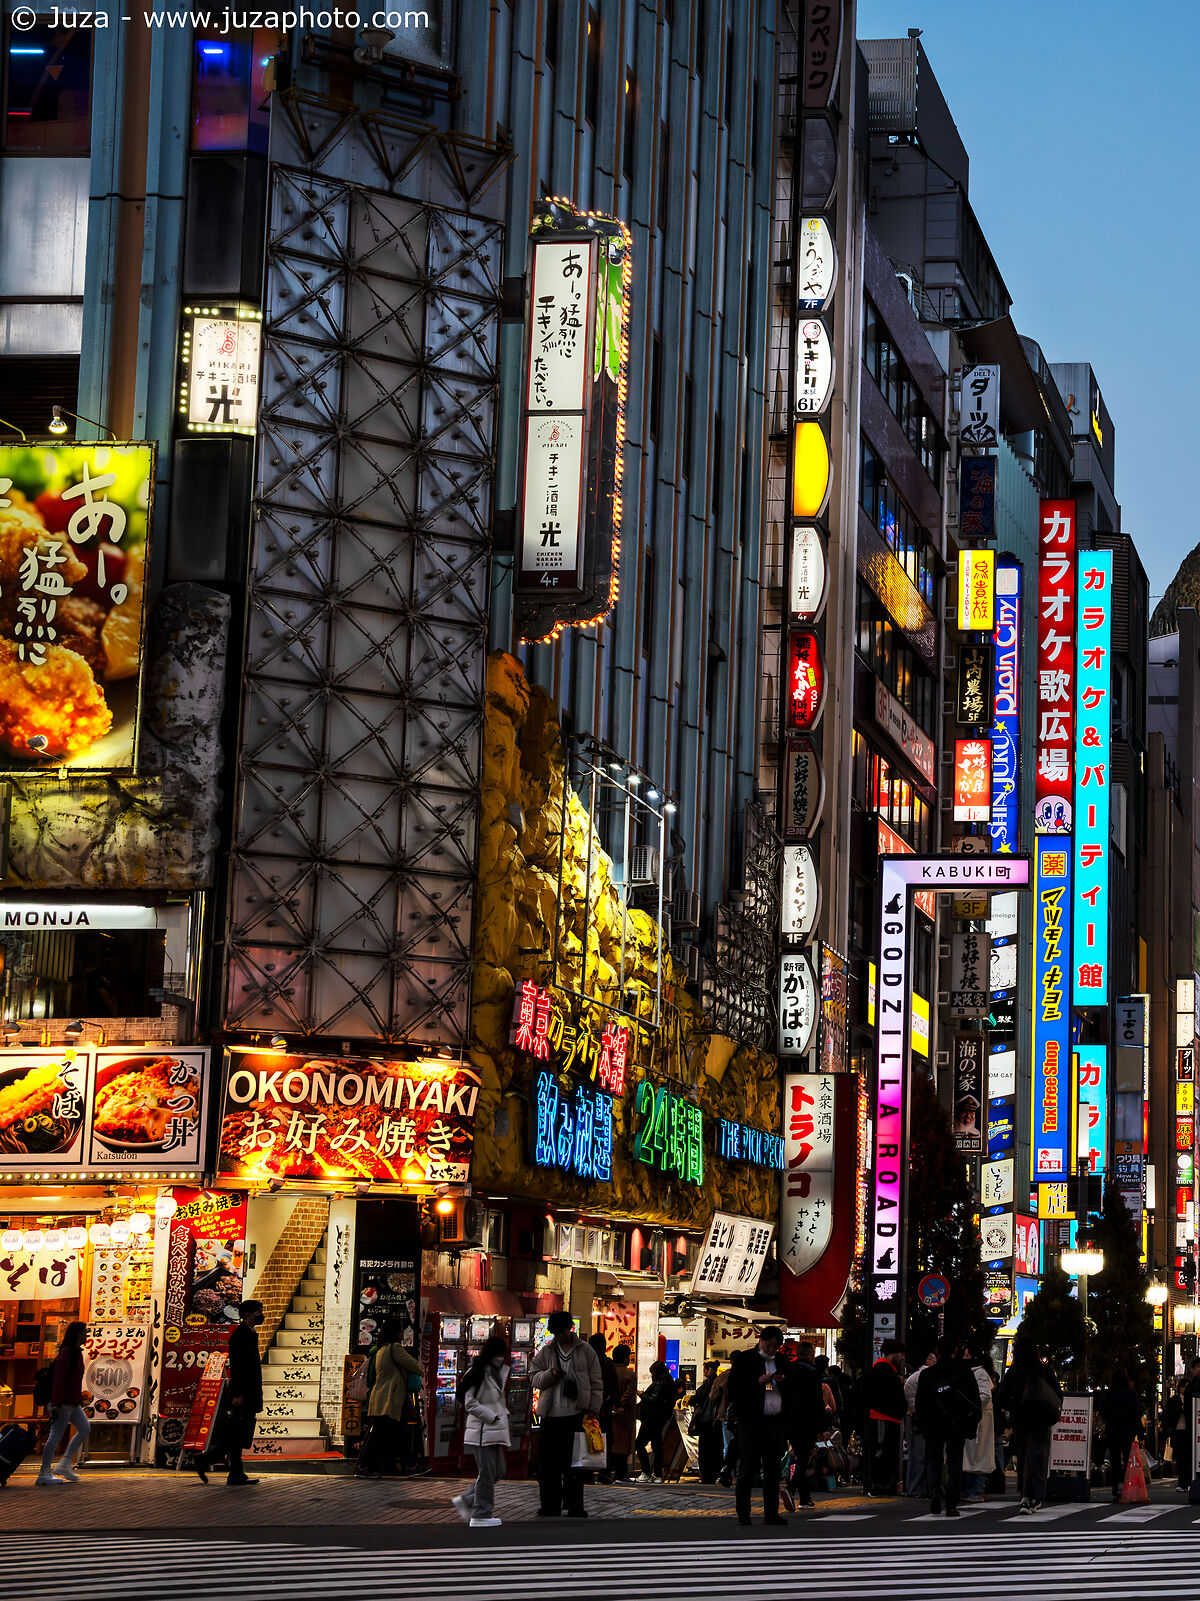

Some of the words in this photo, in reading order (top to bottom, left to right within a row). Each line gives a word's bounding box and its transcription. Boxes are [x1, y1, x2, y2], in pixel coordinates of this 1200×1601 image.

[804, 300, 819, 309] 7F
[195, 371, 257, 385] チキン酒場
[205, 385, 243, 425] 光
[969, 379, 991, 430] ダーツ
[545, 453, 560, 517] チキン酒場
[539, 521, 562, 548] 光
[540, 572, 560, 588] 4F
[14, 541, 74, 667] 猛烈に
[995, 598, 1016, 646] City
[1038, 510, 1072, 783] カラオケ歌広場
[962, 649, 985, 714] 山内農場
[968, 713, 980, 722] 5F
[991, 734, 1013, 840] SHINJUKU
[963, 807, 981, 821] 4F
[1042, 855, 1064, 876] 薬
[4, 911, 91, 926] MONJA
[962, 902, 980, 914] 3F
[786, 933, 803, 944] 1F
[783, 962, 805, 972] 新宿
[782, 973, 805, 1030] かっぱ
[879, 921, 904, 1119] GODZILLA
[783, 1037, 802, 1049] B1
[1042, 1041, 1059, 1073] Shop
[1183, 1050, 1192, 1074] ダーツ
[958, 1040, 977, 1092] 海の家
[52, 1059, 81, 1120] そば
[162, 1059, 198, 1151] かつ丼
[228, 1069, 479, 1118] OKONOMIYAKI
[817, 1077, 834, 1142] 大衆酒場
[1042, 1074, 1059, 1106] Free
[238, 1110, 456, 1160] お好み焼き
[535, 1071, 613, 1183] 飲み放題
[636, 1077, 704, 1187] 24時間
[720, 1118, 741, 1160] THE
[1042, 1107, 1059, 1134] Tax
[1177, 1123, 1191, 1147] 麻雀
[96, 1149, 138, 1162] Katsudon
[787, 1084, 815, 1199] トラノコ
[175, 1192, 243, 1220] お好み焼き
[876, 1143, 900, 1238] ROAD
[787, 1207, 809, 1256] やきとん
[805, 1198, 826, 1247] やきとり
[0, 1254, 77, 1292] そば
[166, 1225, 191, 1328] 食べ飲み放題
[88, 1349, 137, 1361] サービス
[94, 1367, 123, 1387] 500
